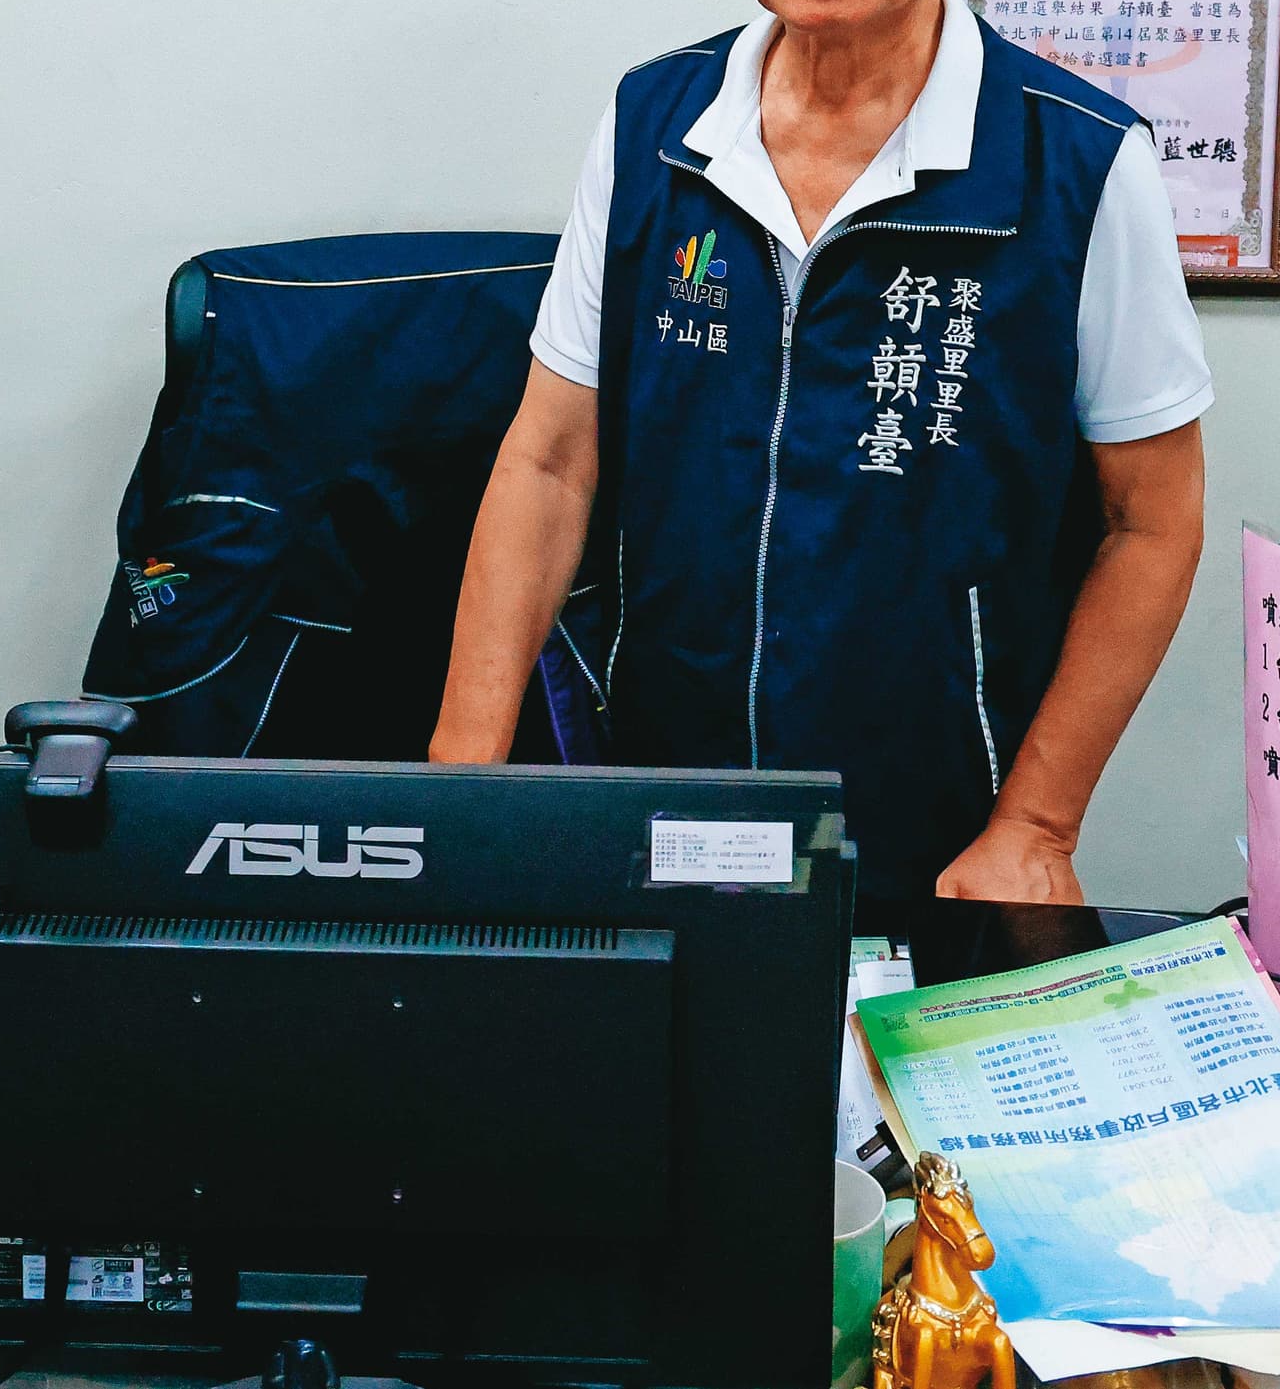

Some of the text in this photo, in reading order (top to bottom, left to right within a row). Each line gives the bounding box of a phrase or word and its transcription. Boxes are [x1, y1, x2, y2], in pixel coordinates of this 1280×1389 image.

[993, 0, 1105, 18] 辦理選舉結果
[1189, 2, 1243, 20] 當選為
[667, 275, 728, 310] TAIPEI
[655, 309, 729, 355] 中山區
[925, 277, 983, 448] 聚盛里里長
[185, 822, 424, 879] ASUS
